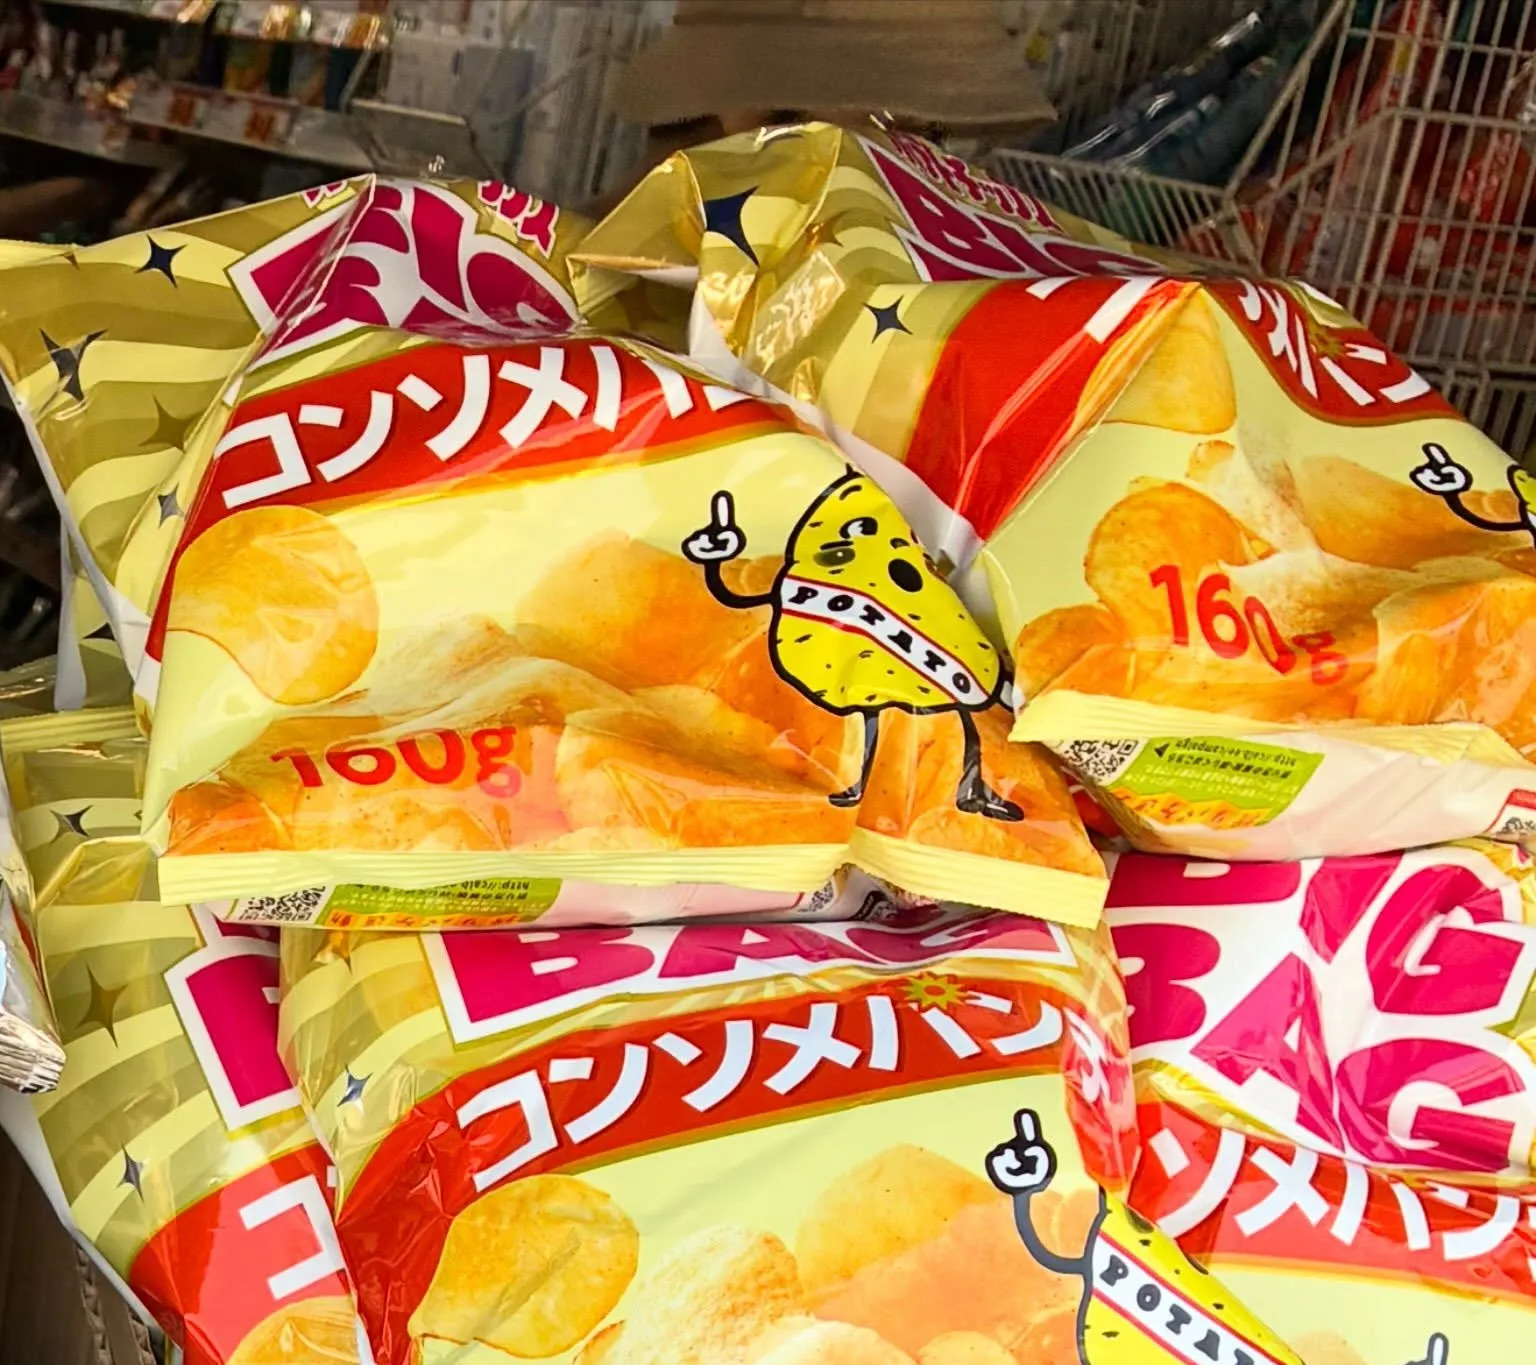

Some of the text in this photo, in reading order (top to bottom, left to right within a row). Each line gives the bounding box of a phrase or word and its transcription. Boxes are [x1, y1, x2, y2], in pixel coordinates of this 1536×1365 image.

[214, 345, 754, 510] コンソメパ
[787, 586, 974, 695] POTATO
[1150, 564, 1349, 685] 160g
[1140, 1125, 1536, 1264] ソメパン
